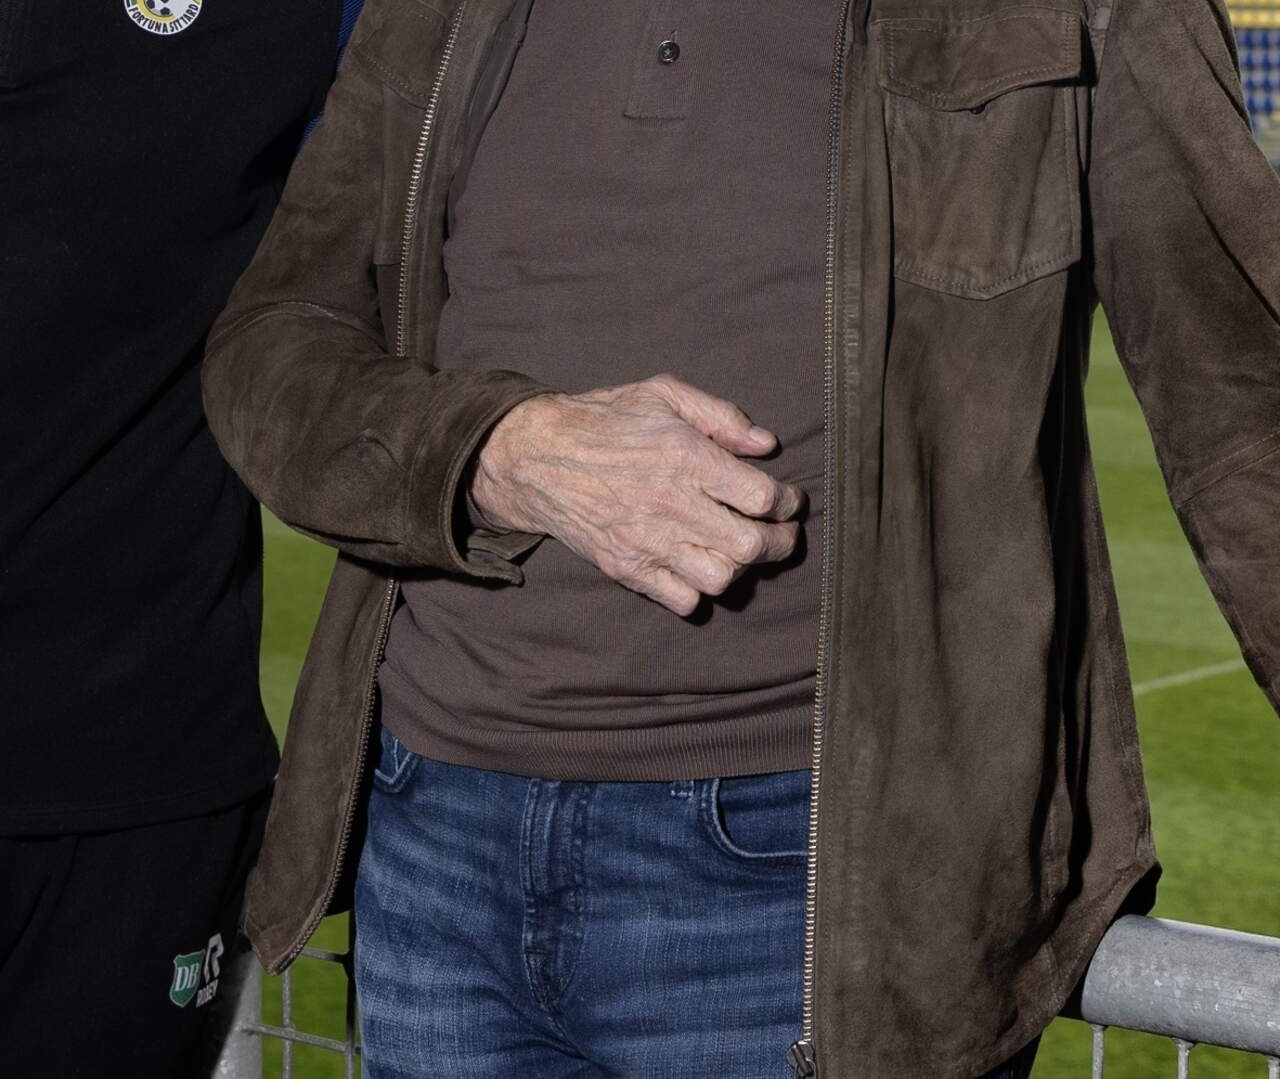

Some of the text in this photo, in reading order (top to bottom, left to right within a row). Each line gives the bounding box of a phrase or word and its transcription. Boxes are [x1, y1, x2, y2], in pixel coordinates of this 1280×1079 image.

[128, 3, 199, 33] FORTUNA SITTARD
[175, 962, 199, 991] DB
